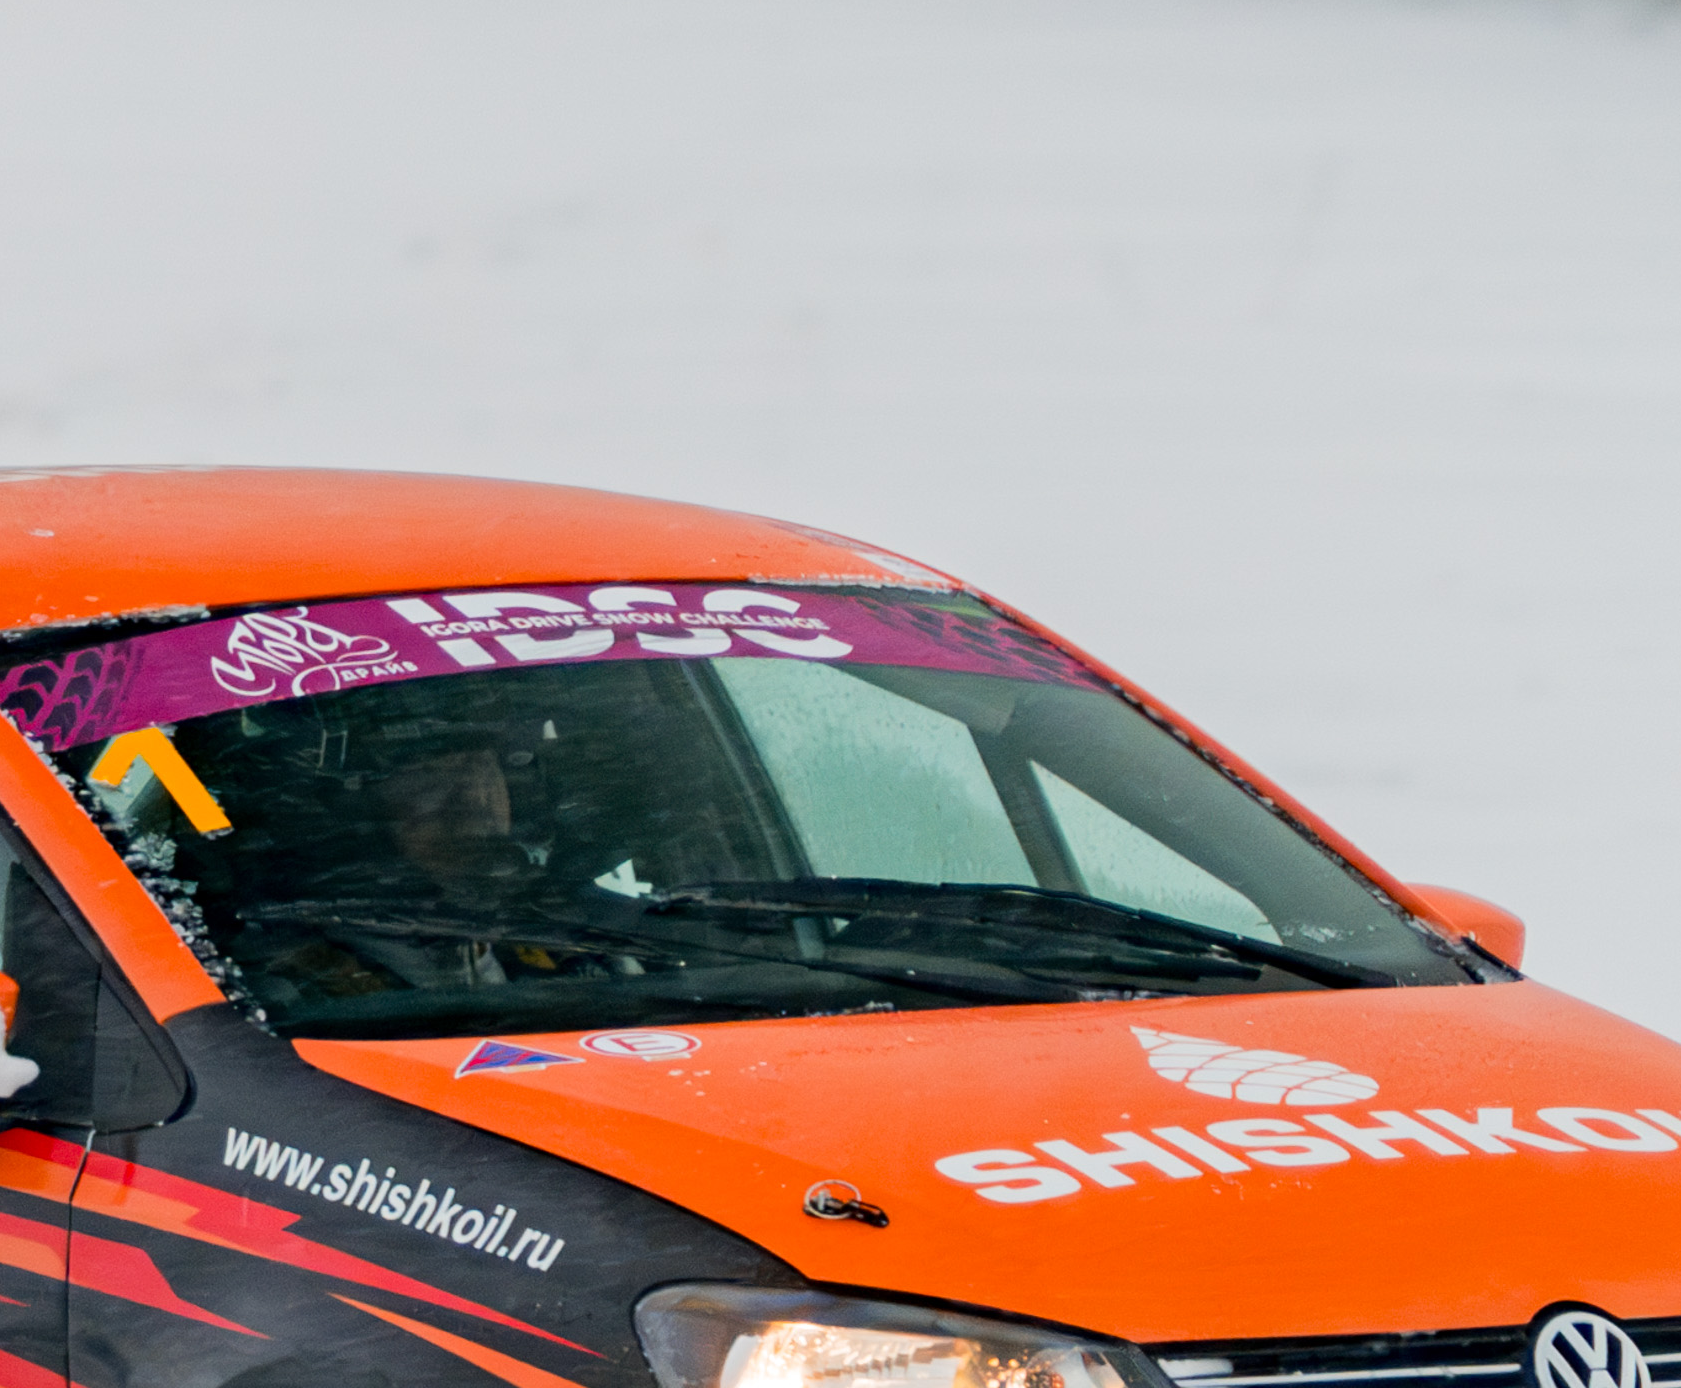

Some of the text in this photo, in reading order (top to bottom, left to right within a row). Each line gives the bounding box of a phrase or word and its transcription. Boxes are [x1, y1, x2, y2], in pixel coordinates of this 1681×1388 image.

[385, 586, 853, 668] IDSC
[420, 612, 831, 638] IGORA DRIVE SNOW CHALLENGE
[88, 726, 234, 835] 1
[222, 1126, 566, 1273] www.shishkoil.ru
